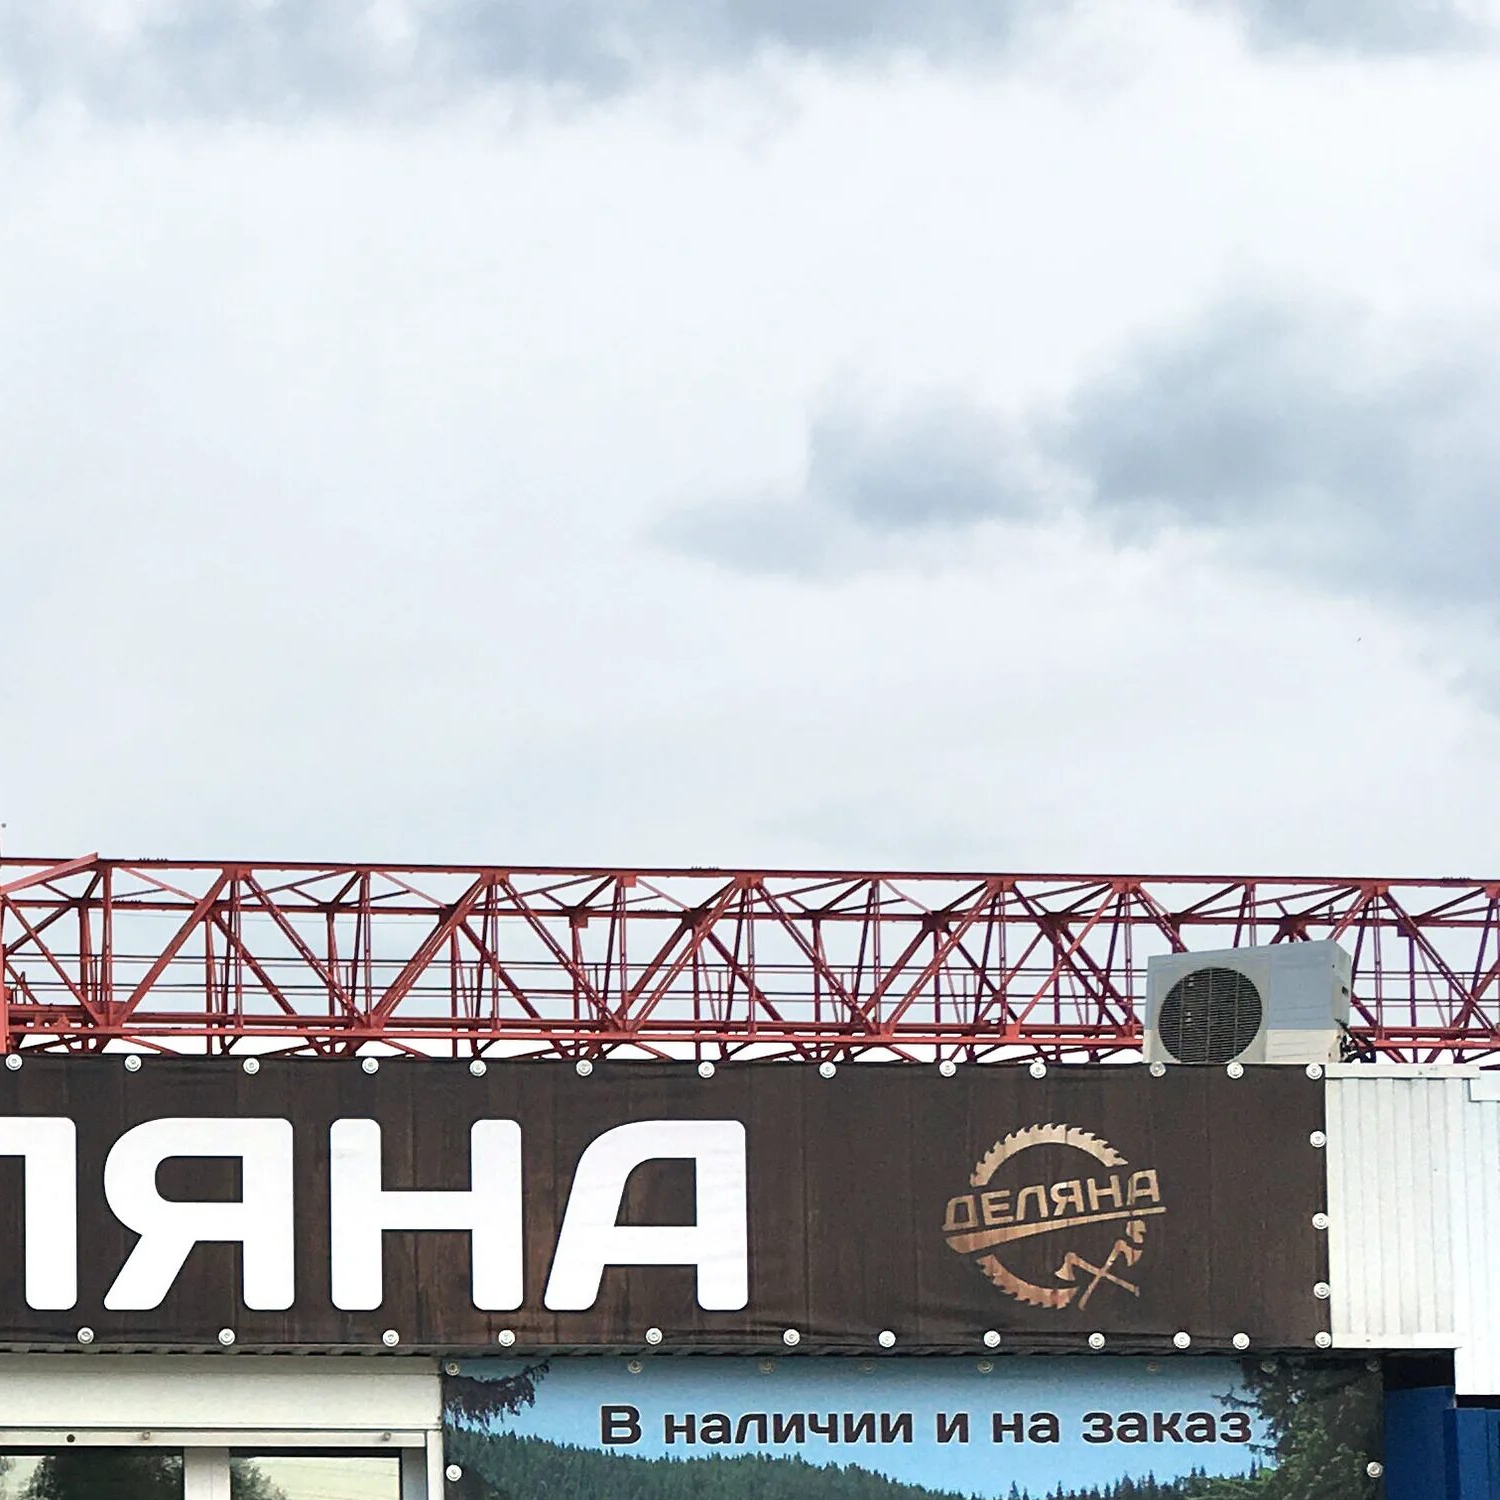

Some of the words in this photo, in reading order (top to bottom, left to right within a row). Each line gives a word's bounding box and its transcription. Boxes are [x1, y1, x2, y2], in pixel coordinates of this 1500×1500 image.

[942, 1169, 1161, 1231] ДЕЛЯНА
[600, 1405, 643, 1445] В
[663, 1412, 914, 1445] наличии
[936, 1412, 970, 1444] и
[991, 1412, 1061, 1444] на
[1081, 1410, 1252, 1444] заказ
